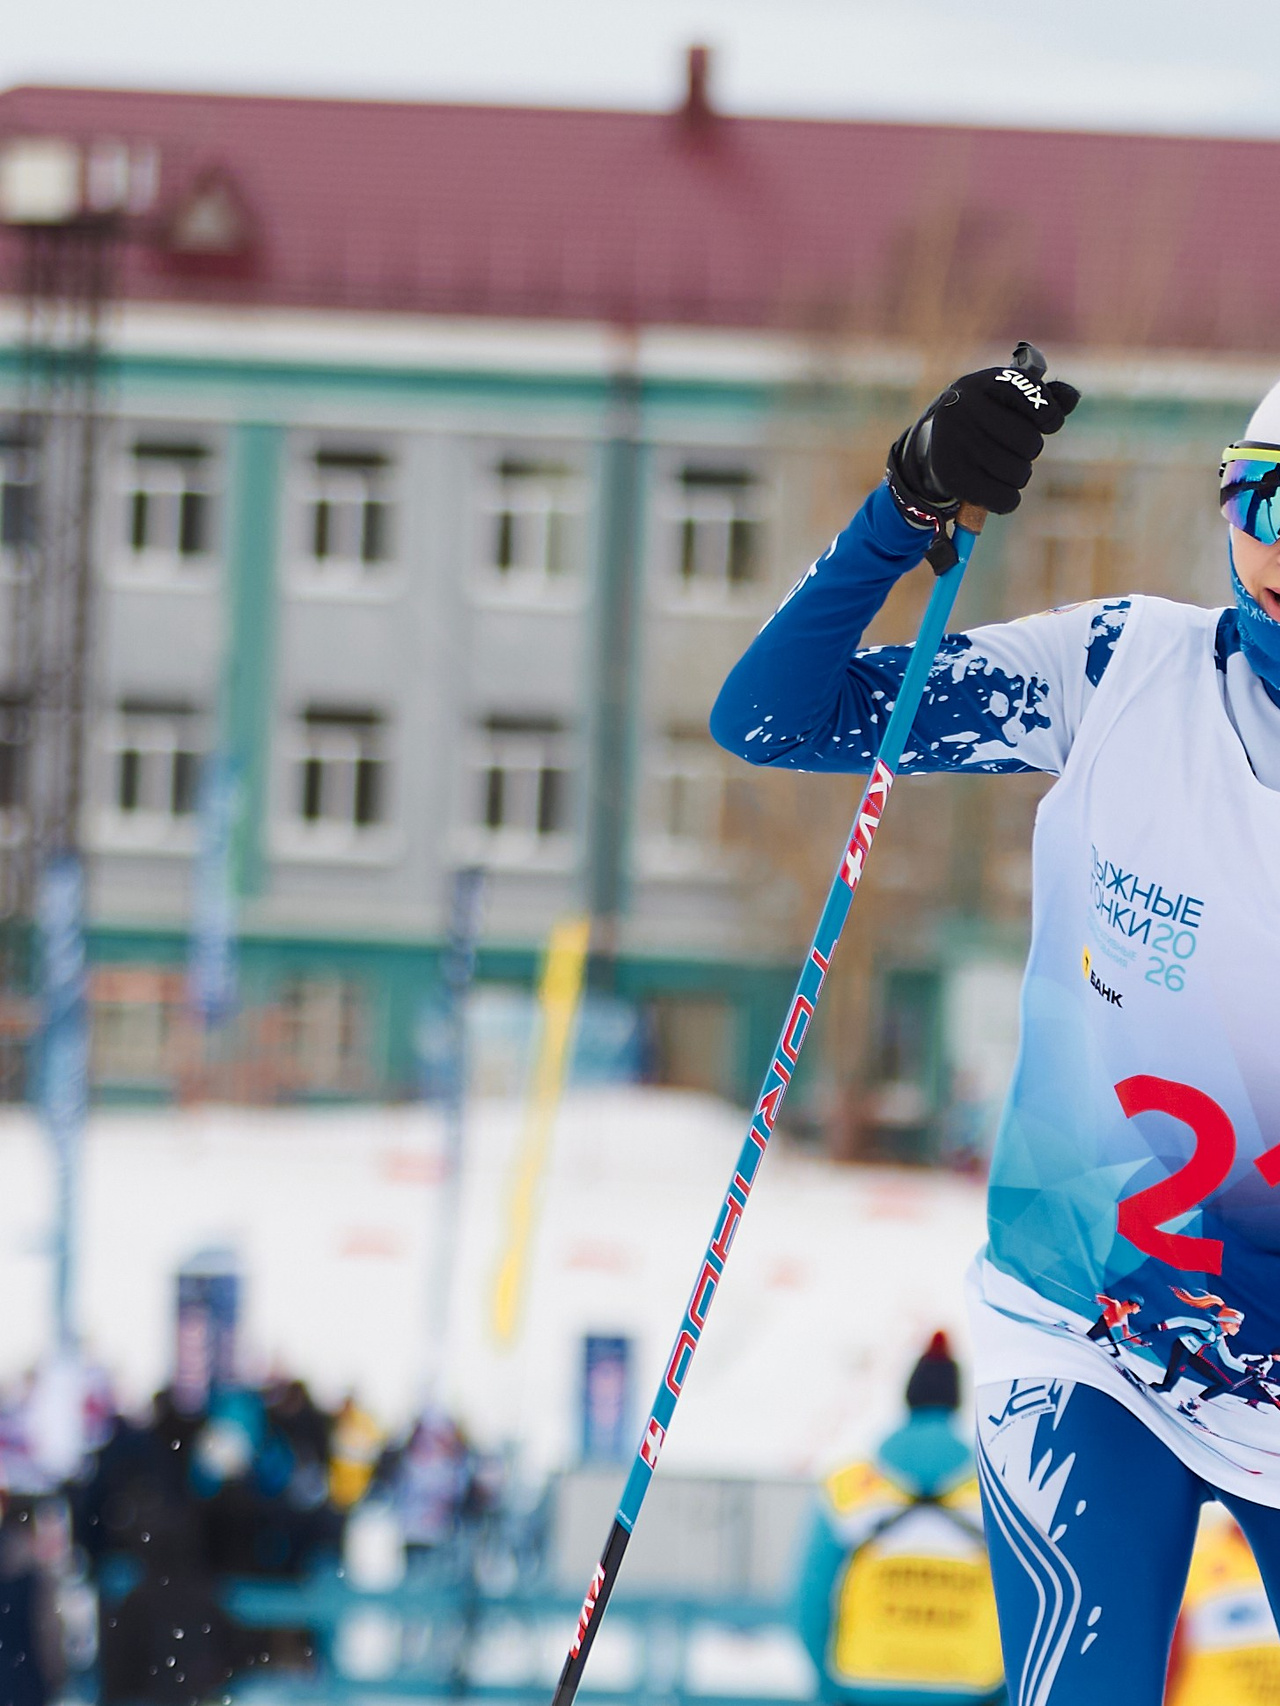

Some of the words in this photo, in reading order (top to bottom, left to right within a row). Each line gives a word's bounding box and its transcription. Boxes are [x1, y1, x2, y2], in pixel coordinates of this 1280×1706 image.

[1152, 923, 1197, 960] 20
[1090, 969, 1124, 1009] БАНК
[1144, 956, 1187, 992] 26
